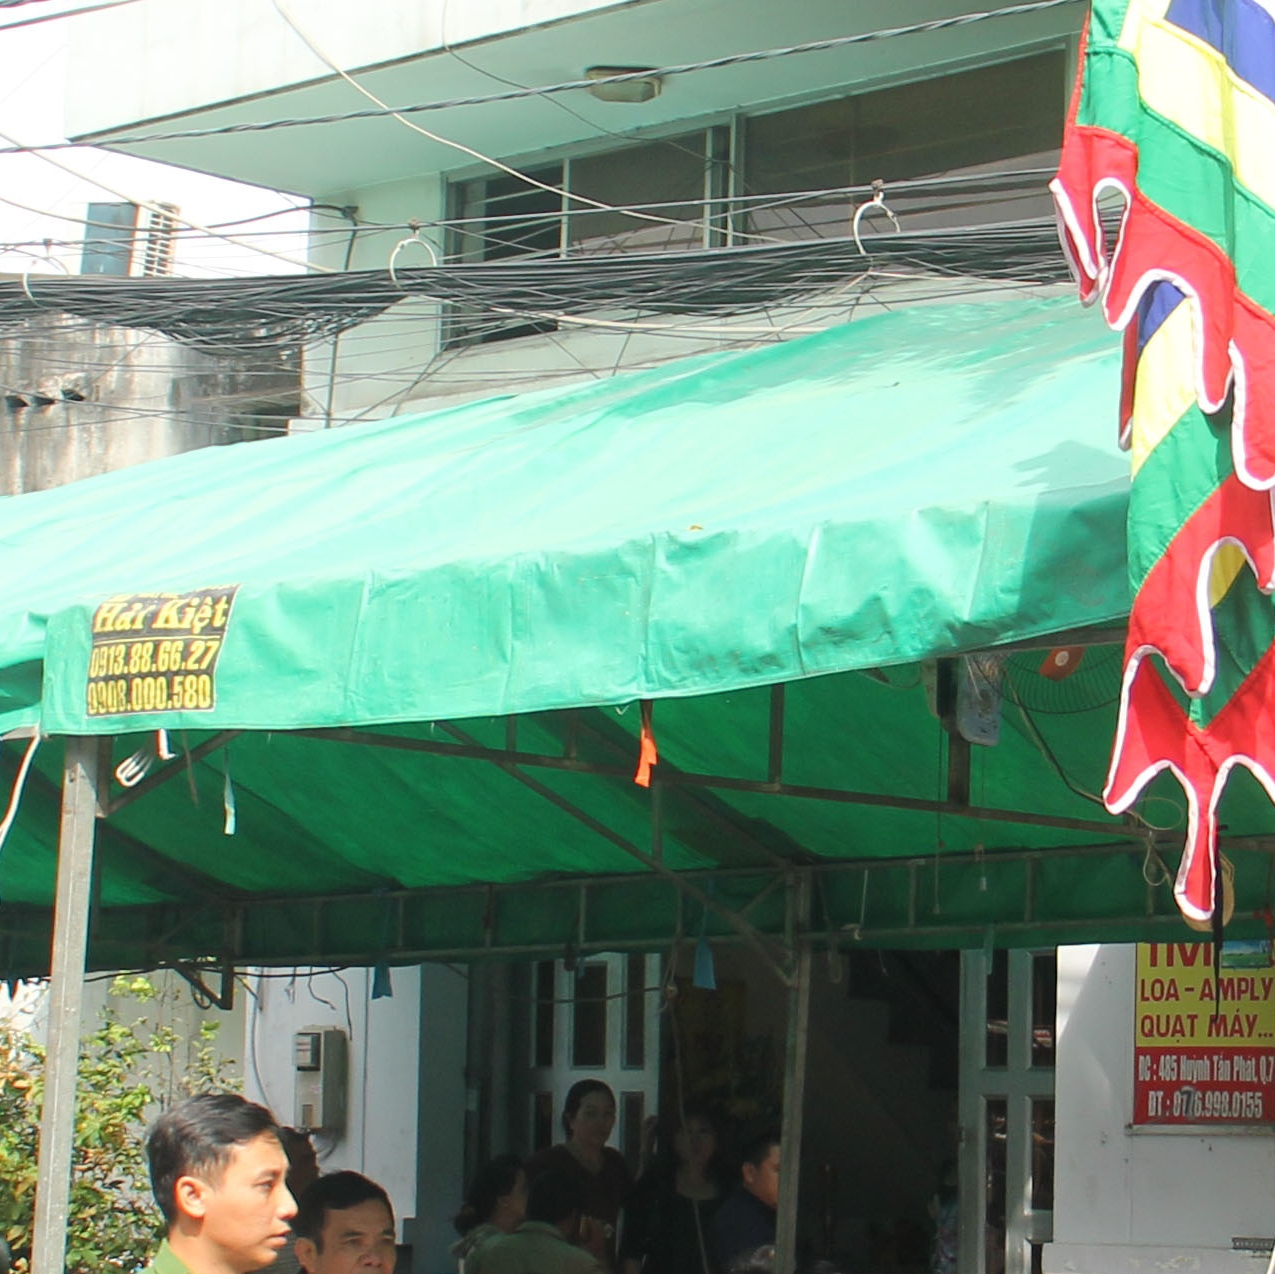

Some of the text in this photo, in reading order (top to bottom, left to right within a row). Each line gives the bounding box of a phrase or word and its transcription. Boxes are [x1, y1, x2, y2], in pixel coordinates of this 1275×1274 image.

[88, 641, 220, 678] 0913.88.66.27
[1140, 978, 1180, 1001] LOA
[1199, 977, 1274, 1001] AMPLY
[1259, 1055, 1275, 1085] Q.7
